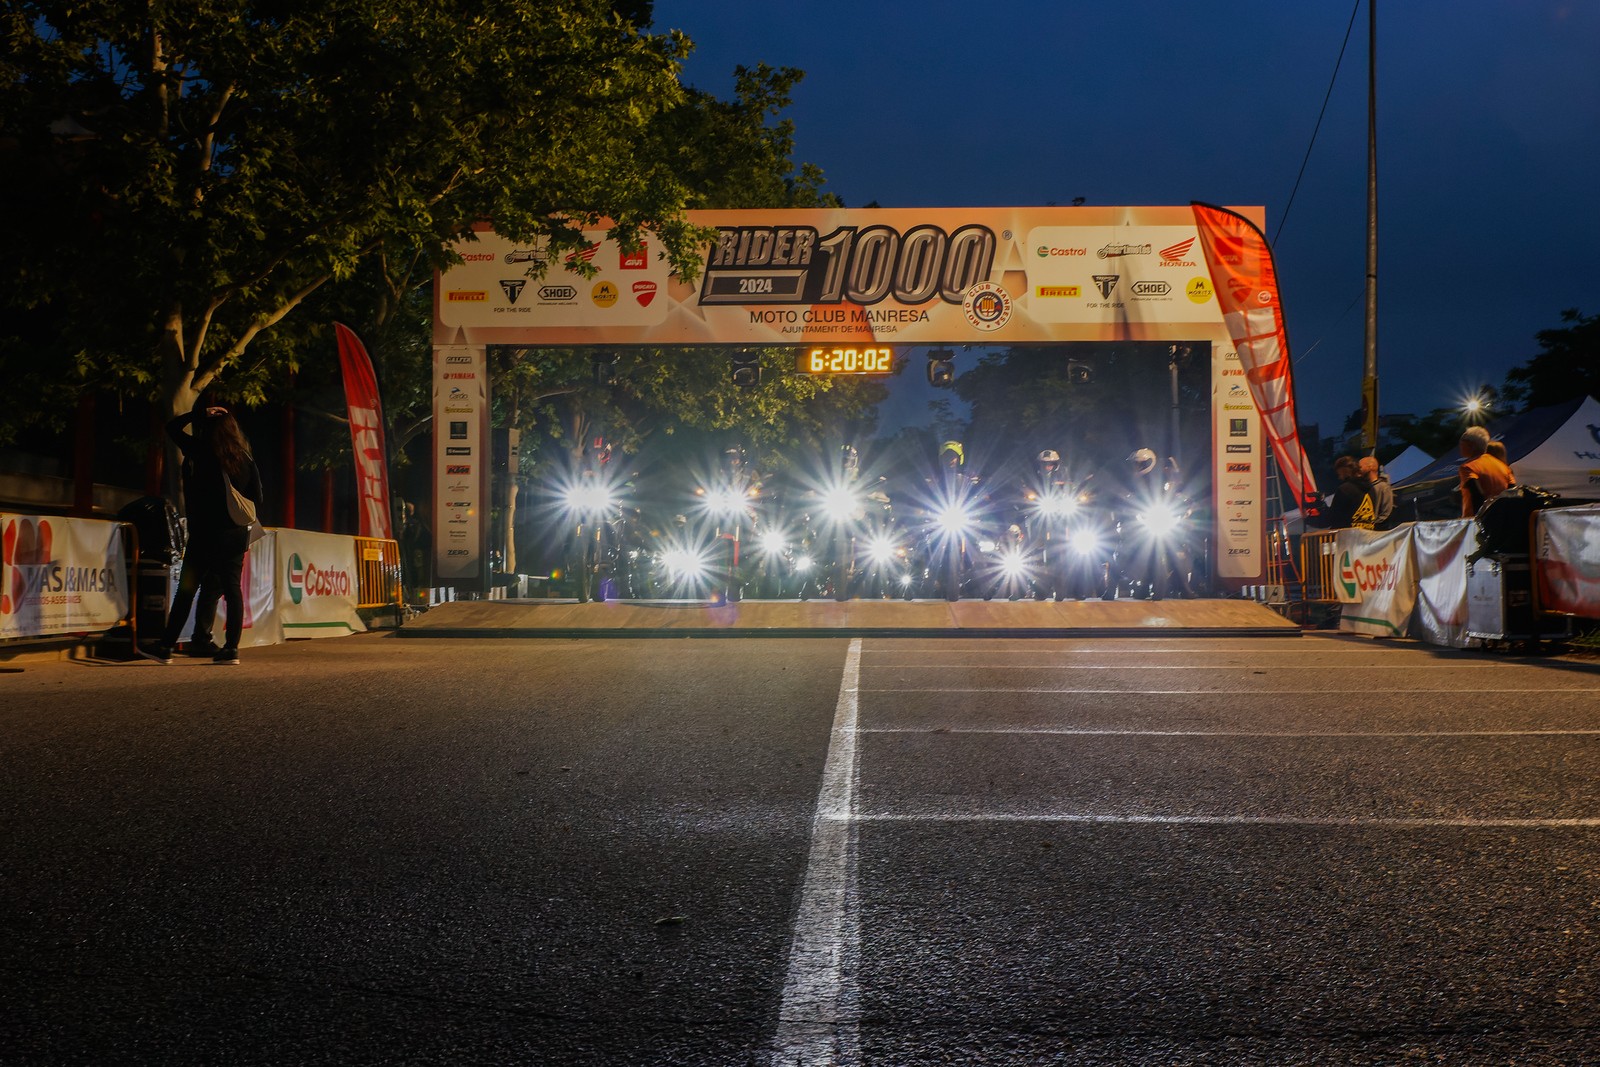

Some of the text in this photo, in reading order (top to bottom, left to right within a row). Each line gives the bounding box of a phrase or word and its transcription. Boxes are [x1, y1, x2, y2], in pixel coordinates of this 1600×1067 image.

[712, 228, 817, 267] RIDER
[1050, 247, 1087, 256] Castrol
[460, 252, 495, 262] Castrol
[818, 225, 995, 304] 1000
[739, 278, 773, 294] 2024
[1137, 283, 1166, 293] SHOEI
[448, 292, 485, 301] PIRELLI
[543, 288, 572, 298] SHOEI
[1040, 287, 1077, 297] PIRELLI
[965, 284, 1010, 326] MOTO CLUB MANRESA
[750, 309, 930, 323] MOTO CLUB MANRESA
[781, 325, 897, 334] AJUNTAMENT DE MANRESA
[810, 349, 891, 371] 6:20:02
[447, 466, 470, 474] KTM
[1228, 464, 1251, 472] KTM
[1354, 556, 1401, 591] Castrol
[305, 562, 351, 596] Castrol
